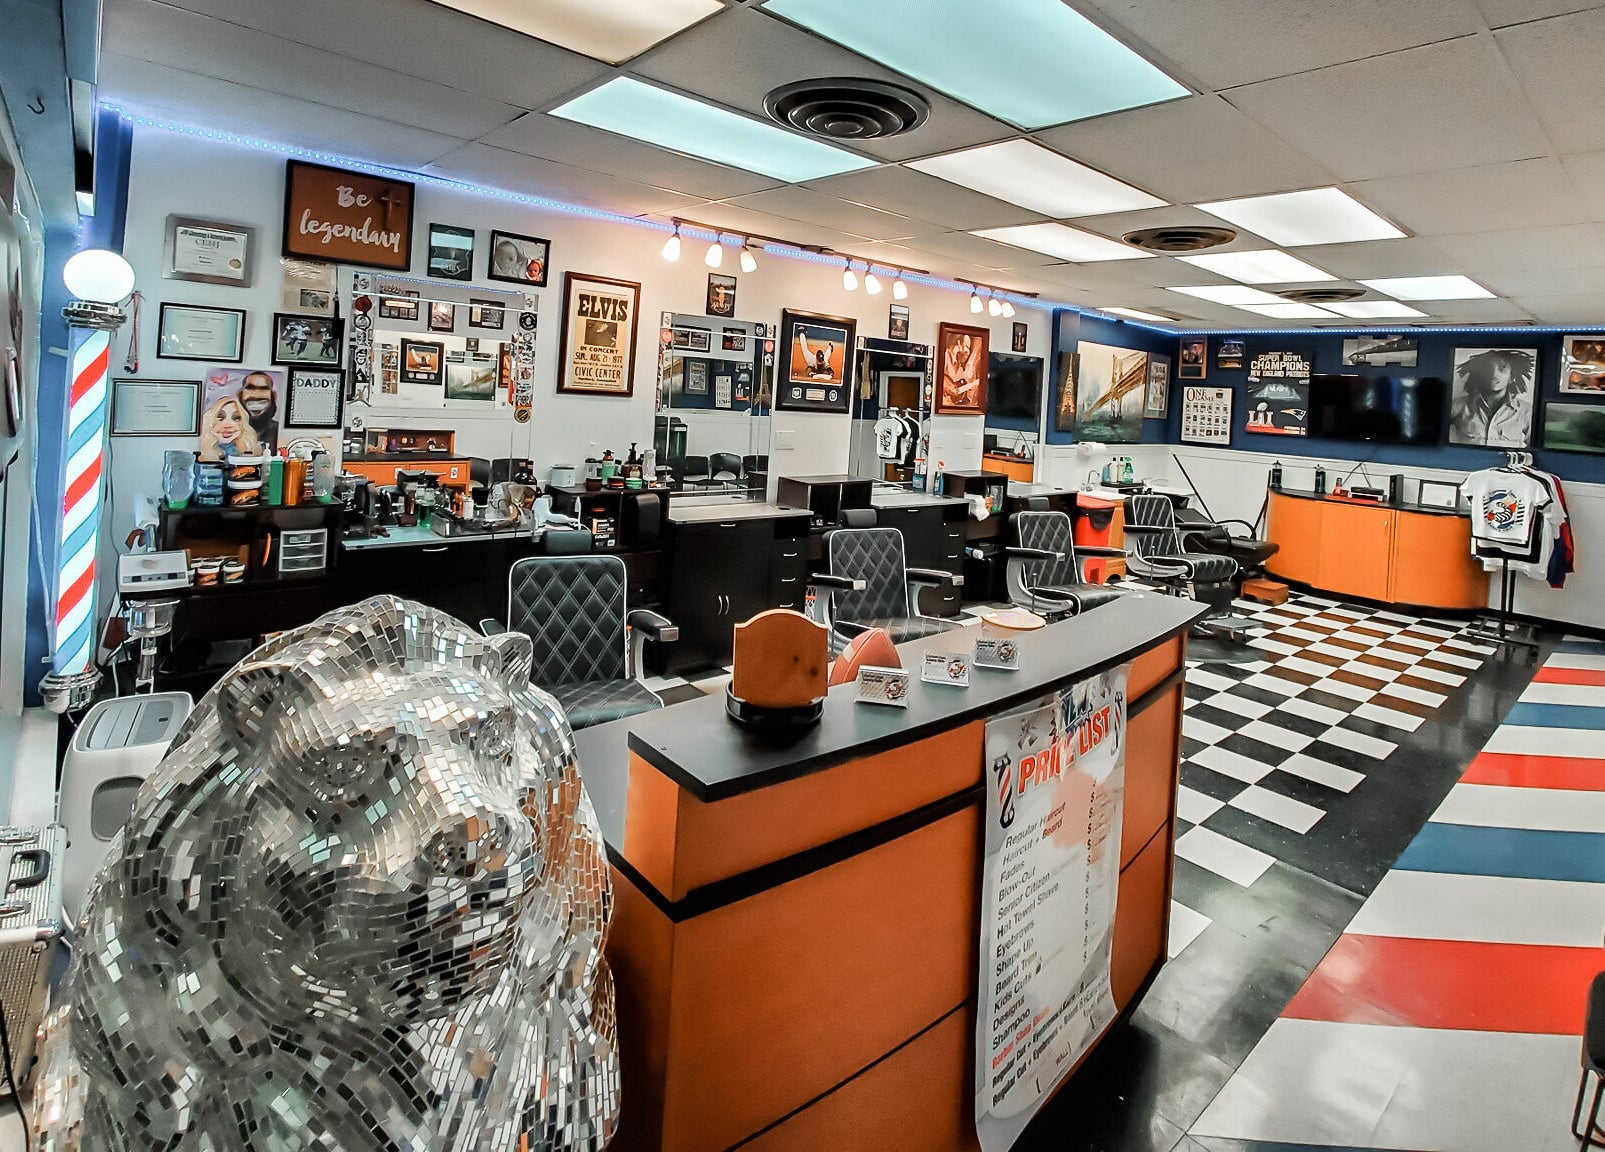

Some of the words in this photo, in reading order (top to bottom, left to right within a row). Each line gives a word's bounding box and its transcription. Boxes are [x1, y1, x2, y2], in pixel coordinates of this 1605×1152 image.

[336, 185, 373, 208] Be
[299, 208, 401, 253] legendary
[577, 293, 628, 322] ELVIS
[589, 347, 619, 355] CONCERT
[1250, 360, 1310, 371] CHAMPIONS
[1258, 354, 1281, 362] SUPER
[1282, 354, 1302, 362] BOWL
[296, 378, 337, 388] DADDY
[574, 366, 593, 377] CIVIC
[595, 368, 621, 380] CENTER
[1186, 387, 1207, 401] ONE
[1077, 705, 1111, 757] LIST
[1002, 838, 1034, 867] Haircut
[1041, 818, 1063, 840] Beard
[1005, 823, 1038, 849] Regular
[1039, 801, 1066, 827] Haircut
[998, 866, 1036, 903] Blow-Out
[1000, 860, 1025, 884] Fades
[996, 919, 1012, 940] Hot
[1014, 898, 1036, 924] Towel
[1037, 882, 1059, 906] Shave
[997, 894, 1023, 921] Senior
[1025, 872, 1050, 899] Citizen
[996, 920, 1035, 958] Eyebrows
[996, 949, 1021, 977] Shape
[1023, 938, 1034, 953] Up
[995, 965, 1020, 996] Beard
[1021, 951, 1039, 971] Trim
[994, 990, 1013, 1014] Kids
[1014, 972, 1032, 995] Cuts
[992, 1008, 1031, 1051] Shampoo
[993, 995, 1025, 1032] Designs
[992, 1057, 1016, 1089] Regular
[1016, 1045, 1027, 1062] Cut
[992, 1075, 1016, 1107] Regular
[1016, 1062, 1027, 1080] Cut
[1032, 1027, 1058, 1061] Eyebrows
